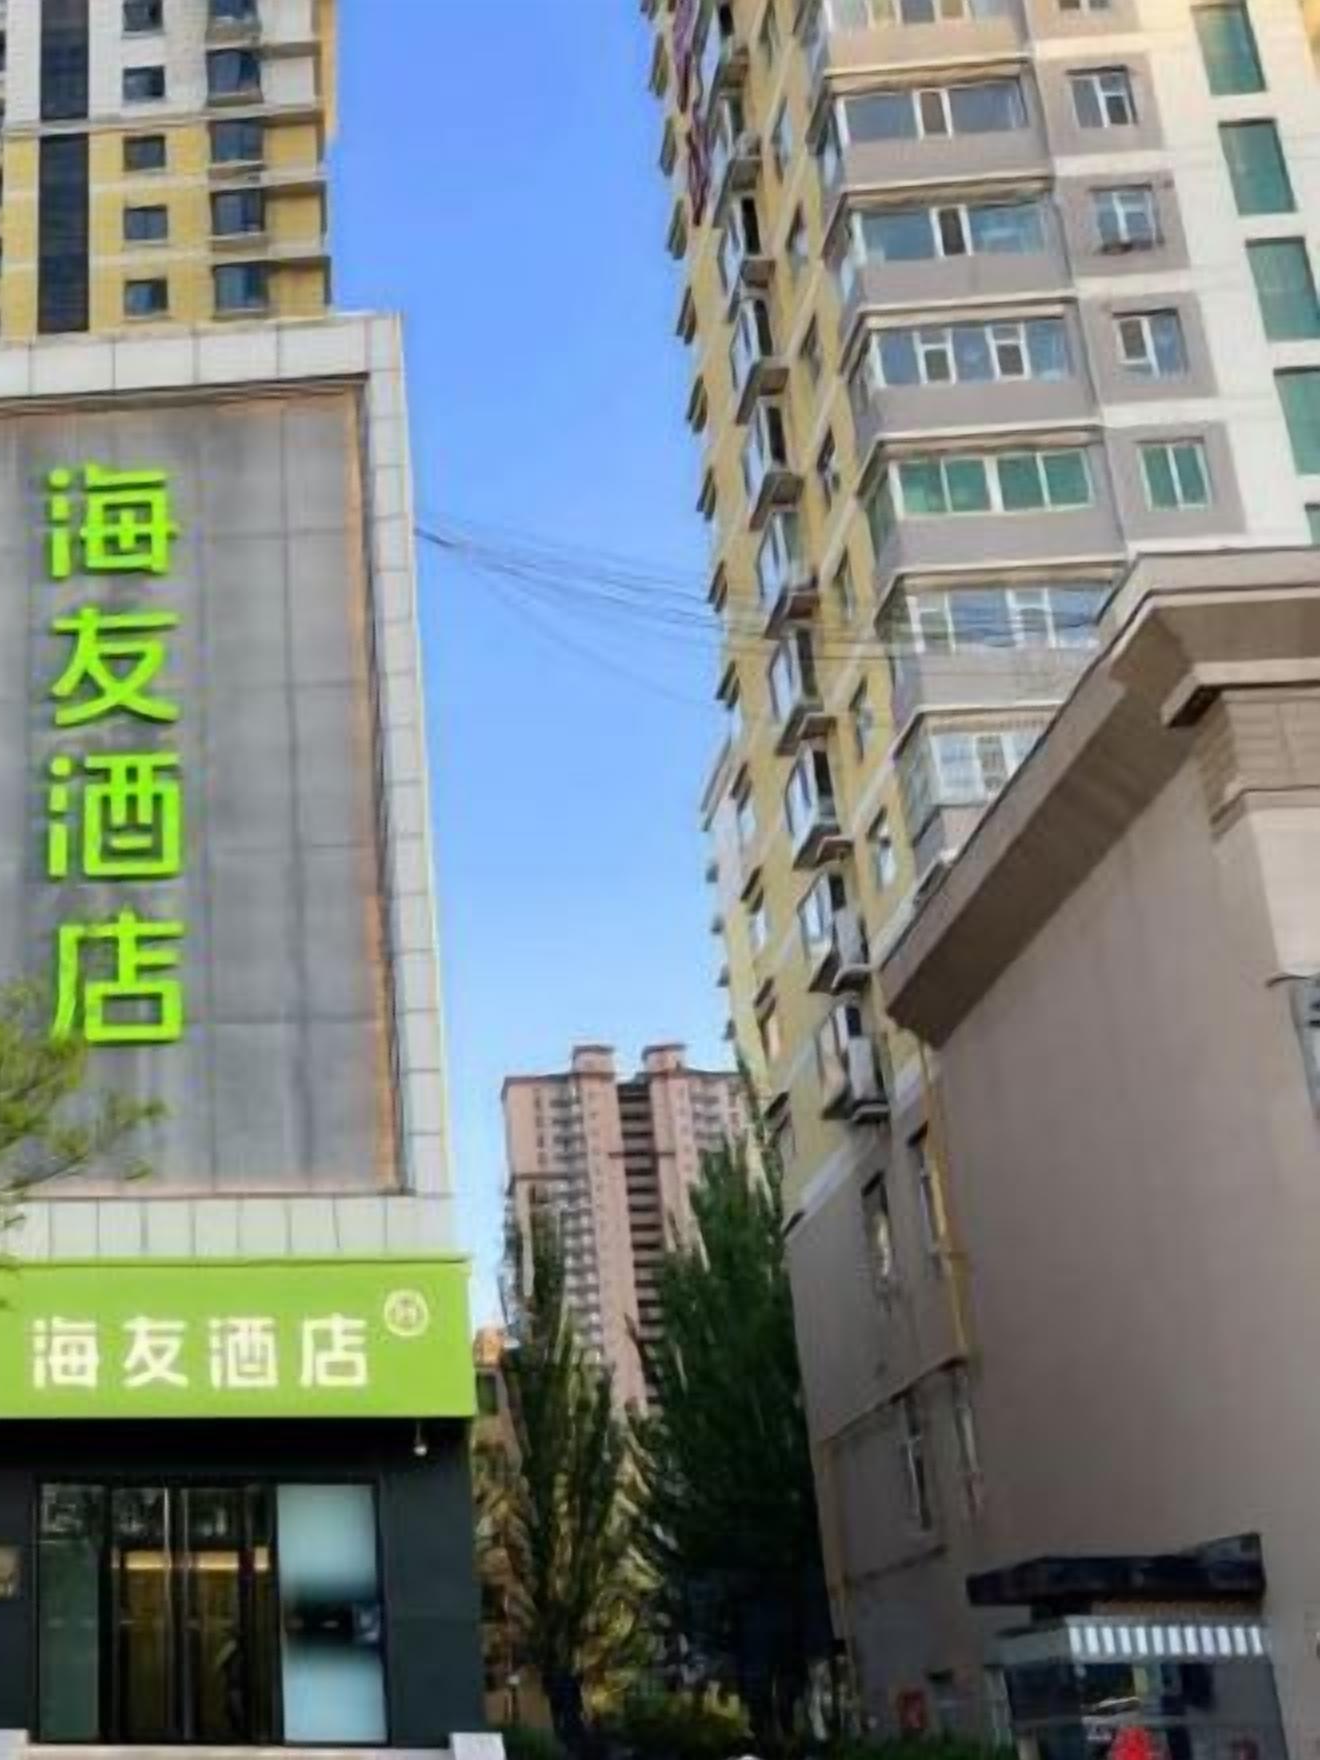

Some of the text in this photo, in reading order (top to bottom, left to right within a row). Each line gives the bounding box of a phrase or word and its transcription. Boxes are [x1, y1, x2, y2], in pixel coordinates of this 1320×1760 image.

[46, 463, 184, 1044] 海友酒店
[32, 1315, 369, 1389] 海友酒店
